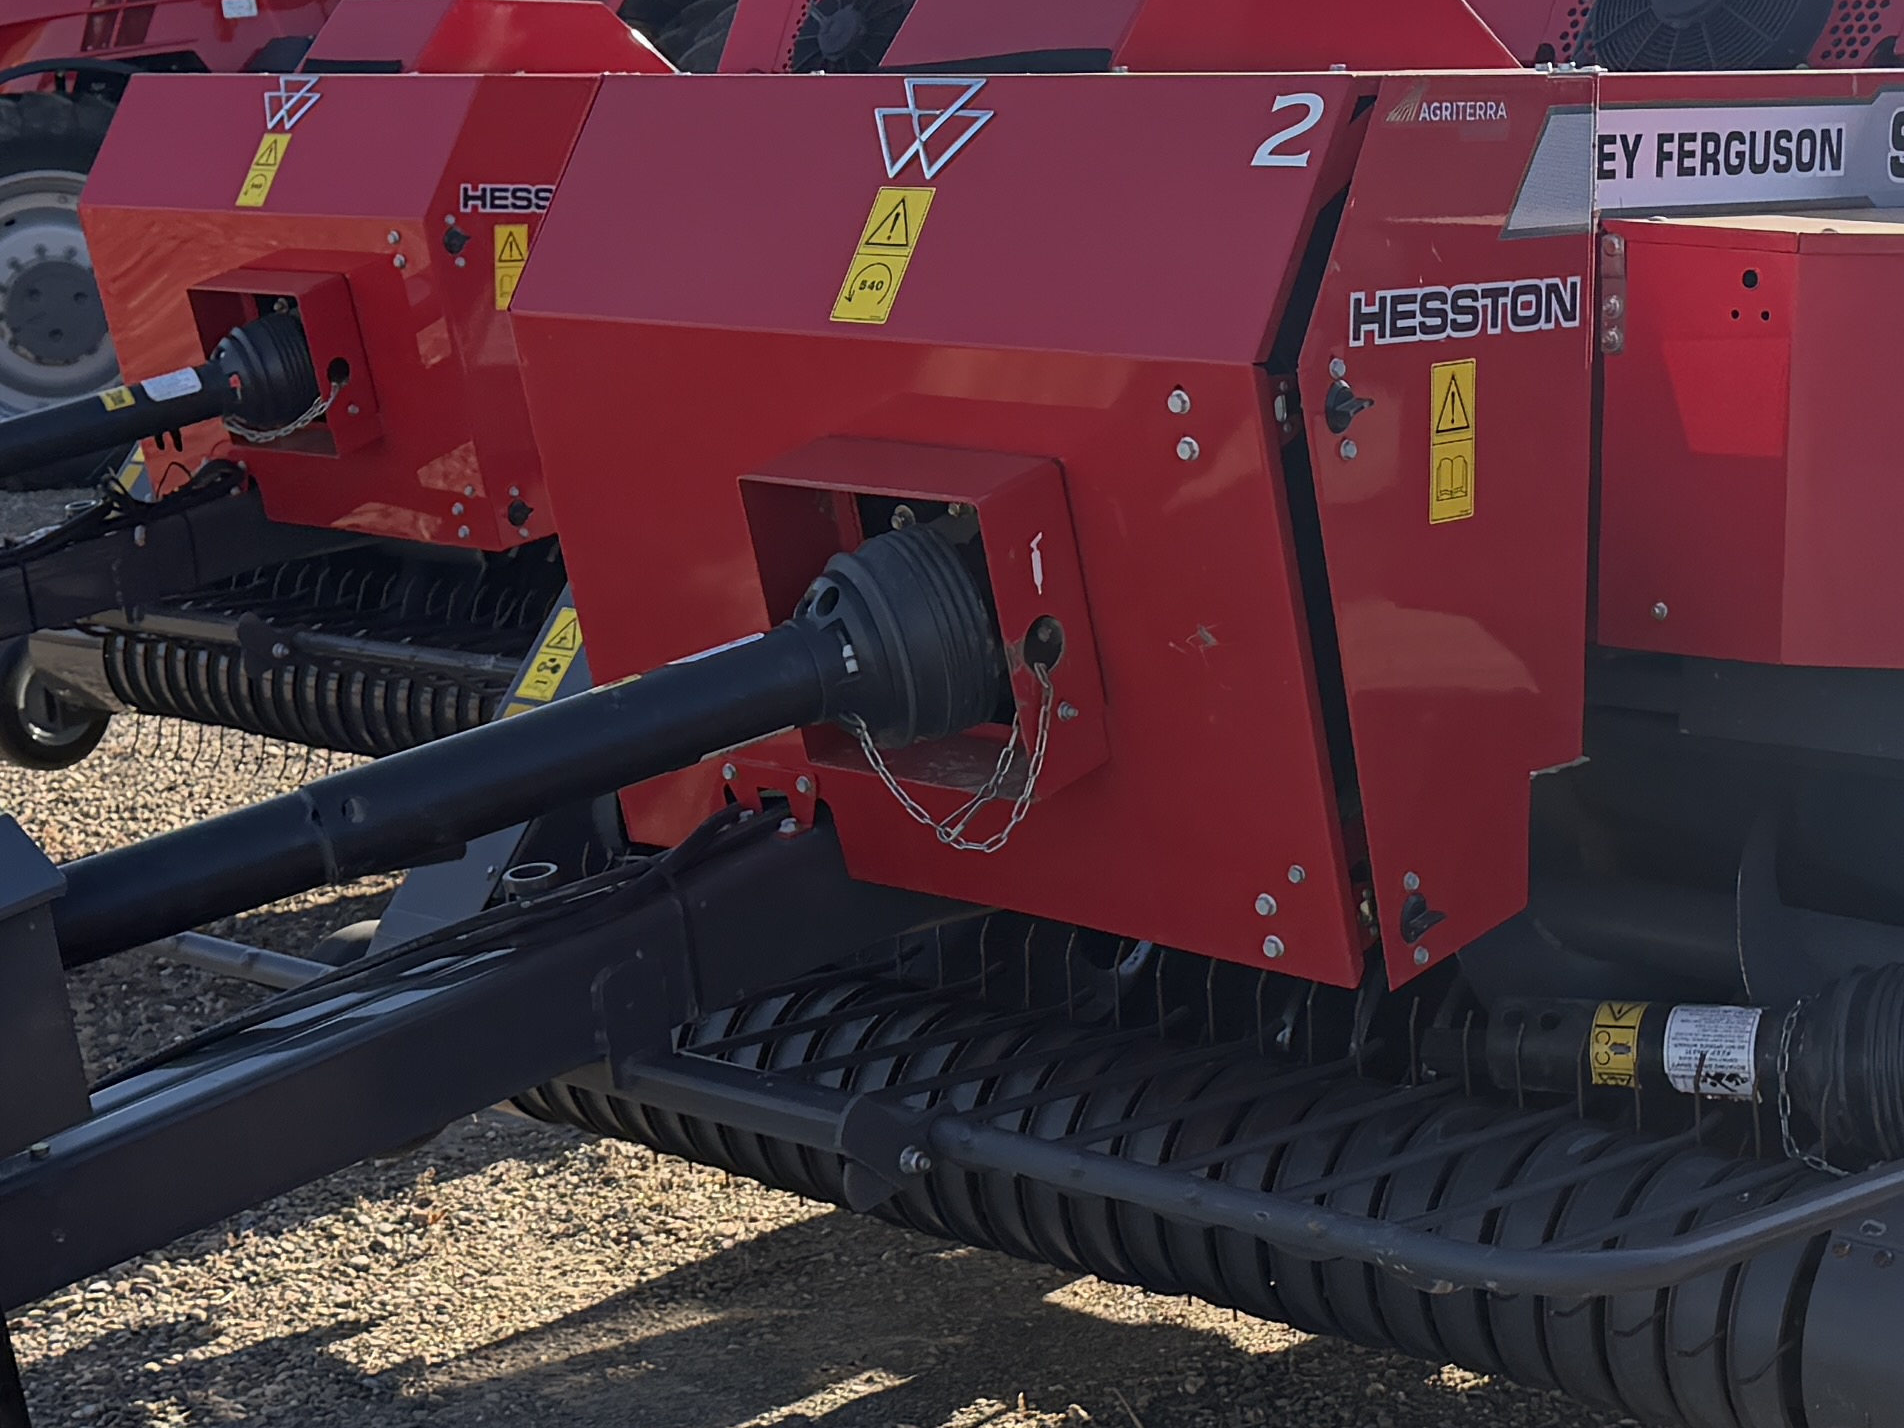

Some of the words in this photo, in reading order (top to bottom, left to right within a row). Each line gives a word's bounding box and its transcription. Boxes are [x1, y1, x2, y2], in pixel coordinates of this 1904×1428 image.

[1250, 92, 1324, 167] 2
[1418, 101, 1507, 122] AGRITERRA
[1596, 133, 1644, 180] EY
[1655, 128, 1843, 178] FERGUSON
[859, 279, 884, 291] 540
[1350, 277, 1581, 347] HESSTON
